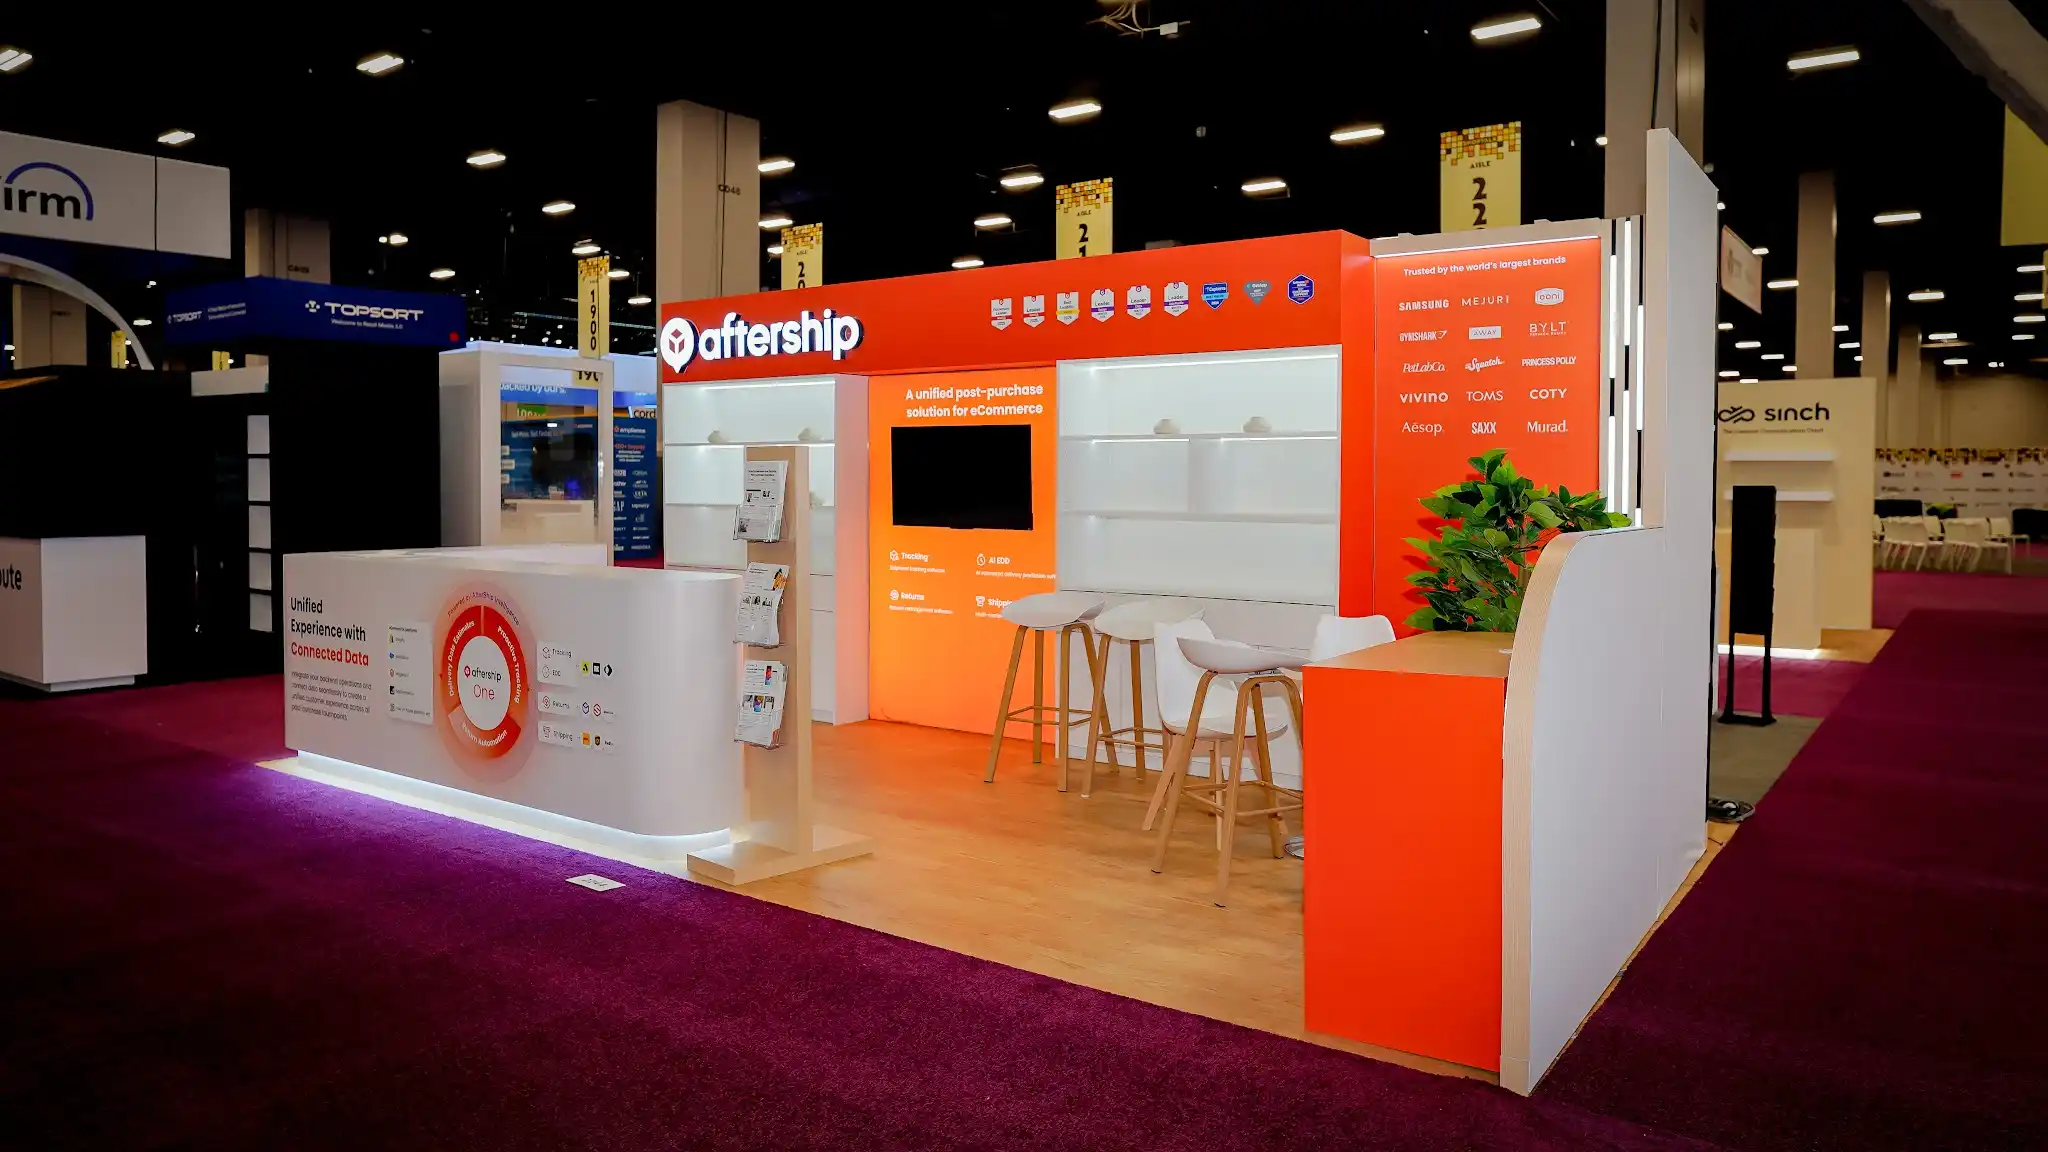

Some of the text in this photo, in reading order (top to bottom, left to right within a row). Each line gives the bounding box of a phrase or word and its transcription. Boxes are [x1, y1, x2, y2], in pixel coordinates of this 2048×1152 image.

[1470, 161, 1491, 169] AISLE
[0, 176, 81, 219] irm
[1472, 177, 1487, 229] 22
[1403, 255, 1567, 277] Trusted by the world's largest brands
[1461, 295, 1510, 307] MEJURI
[1539, 292, 1560, 301] ooni
[324, 302, 424, 321] TOPSORT
[1399, 299, 1450, 312] SAMSUNG
[699, 308, 863, 361] aftership
[1529, 321, 1567, 333] BYLT
[1521, 356, 1577, 367] PRINCESS POLLY
[905, 384, 1044, 402] A unified post-purchase
[1466, 390, 1504, 402] TOMS
[1529, 388, 1568, 400] COTY
[906, 403, 1044, 418] solution for eCommerce
[1764, 402, 1830, 421] sinch
[1471, 421, 1497, 434] SAXX
[901, 552, 929, 562] Tracking
[900, 591, 925, 600] Returns
[290, 597, 323, 614] Unified
[290, 618, 366, 641] Experience with
[290, 642, 369, 666] Connected Data
[447, 664, 455, 697] Delivery
[453, 620, 475, 645] Estimates
[552, 648, 572, 658] Tracking
[497, 625, 522, 704] Proactive Tracking
[471, 666, 502, 682] aftership
[473, 684, 495, 701] One
[478, 729, 508, 747] Automation
[553, 730, 573, 742] Shipping
